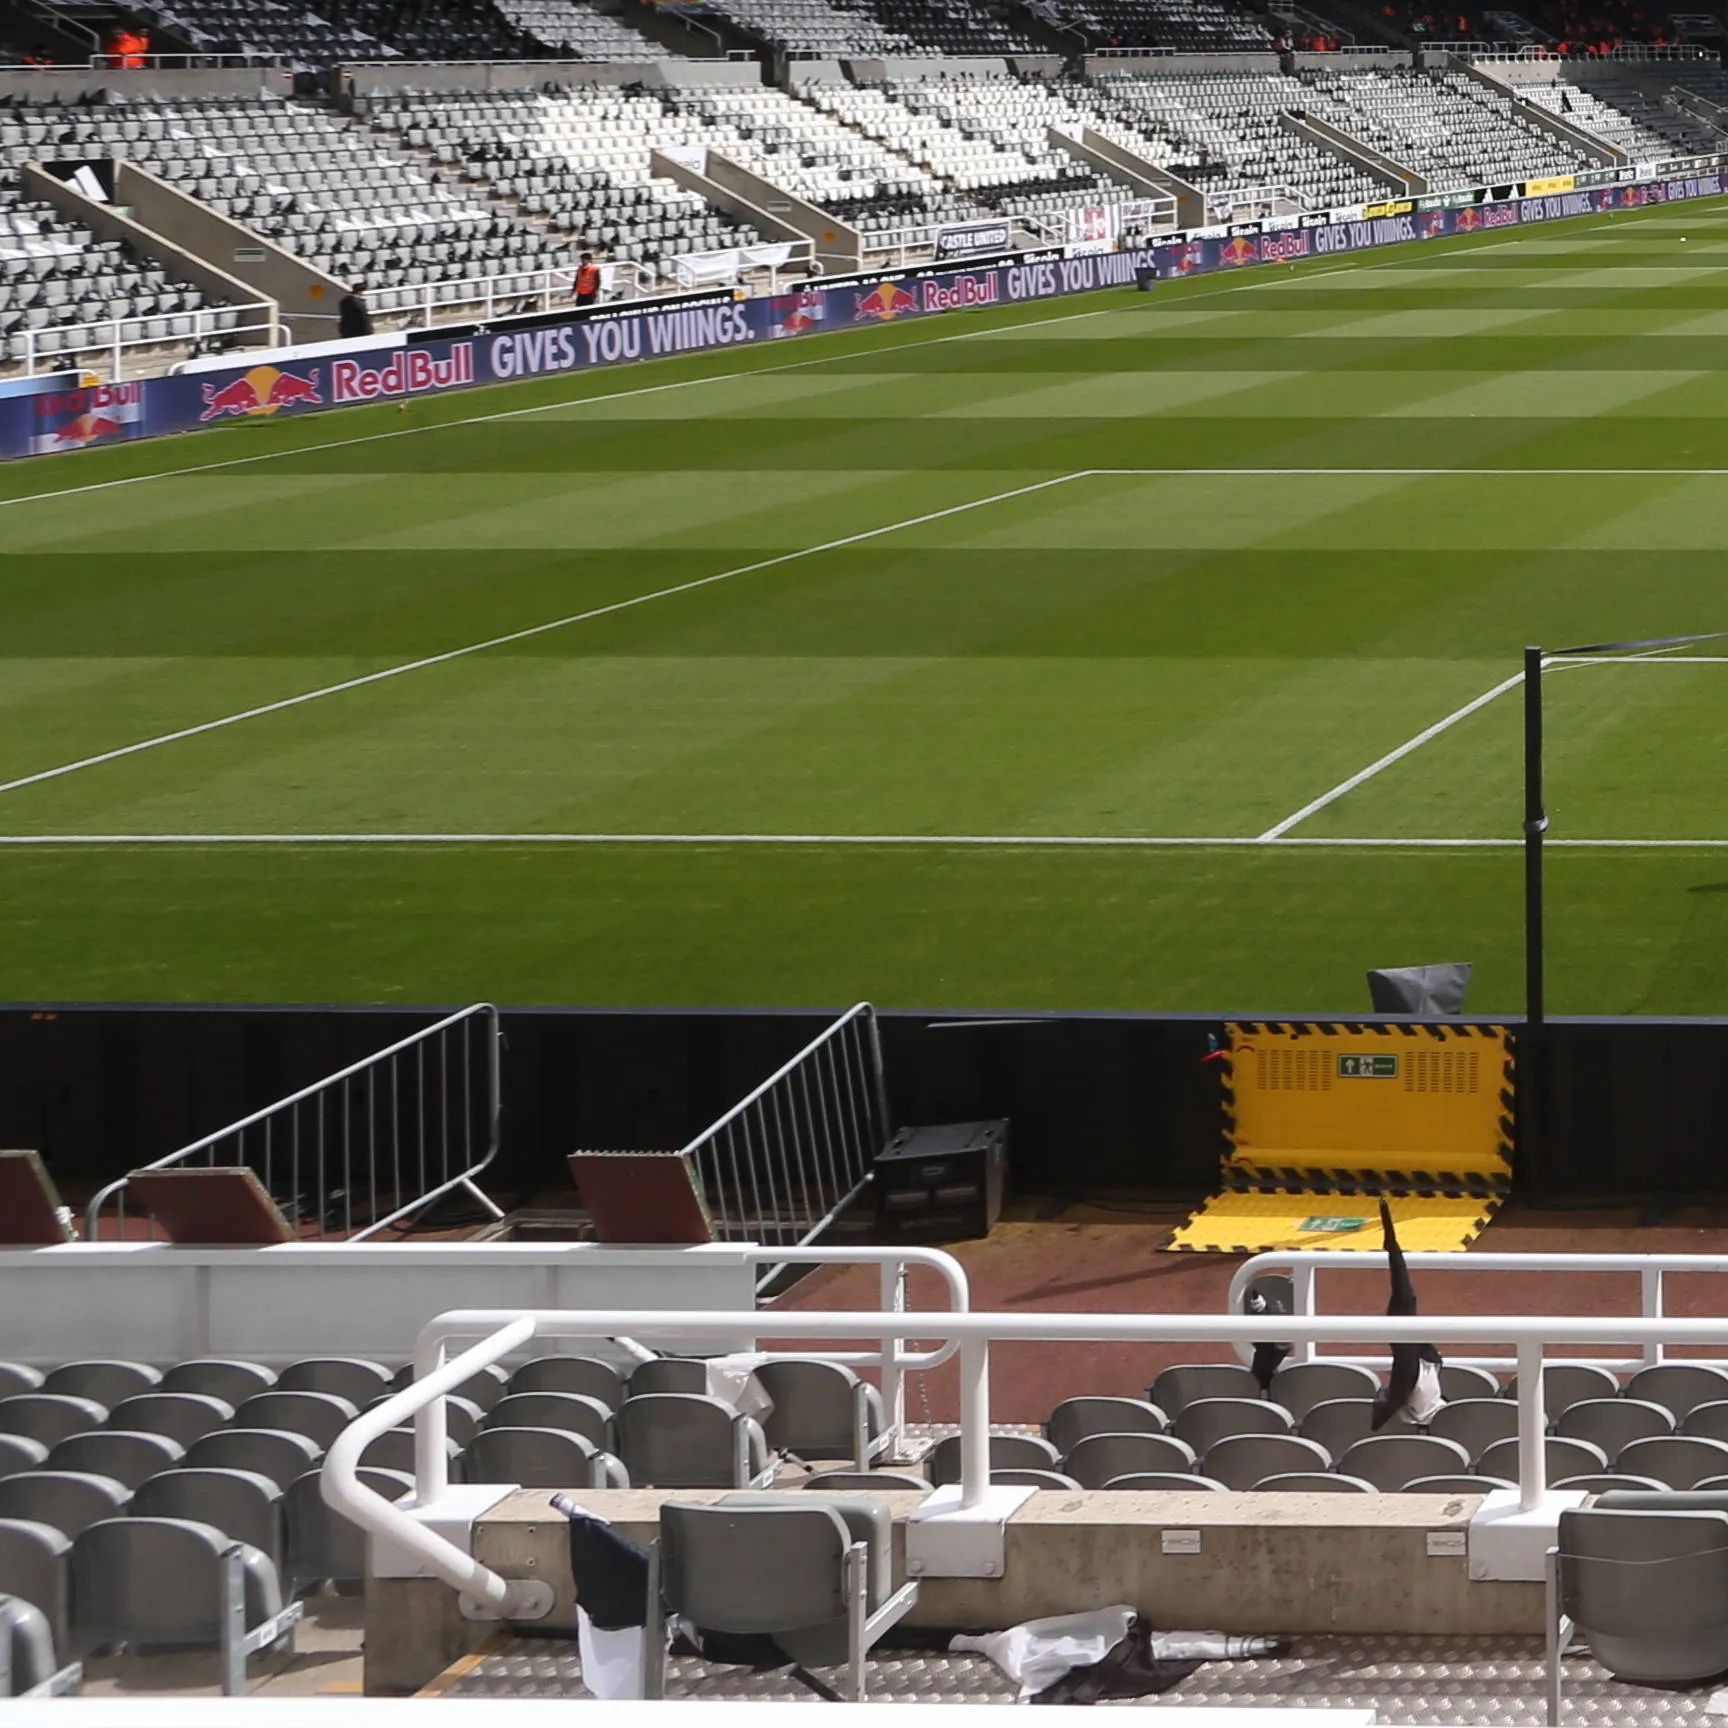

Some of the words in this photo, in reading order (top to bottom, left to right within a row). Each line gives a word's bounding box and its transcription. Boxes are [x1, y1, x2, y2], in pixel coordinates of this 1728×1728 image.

[1521, 198, 1544, 222] GIVES
[1545, 195, 1561, 218] YOU
[1261, 234, 1287, 260] Red
[1287, 229, 1310, 255] Bull
[1315, 223, 1347, 253] GIVES
[1349, 220, 1372, 250] YOU
[1373, 216, 1416, 245] WIIINGS.
[923, 276, 963, 311] Red
[963, 271, 999, 305] Bull
[1007, 263, 1056, 300] GIVES
[1059, 258, 1094, 292] YOU
[491, 325, 576, 379] GIVES
[581, 316, 641, 364] YOU
[649, 303, 756, 354] WIIINGS.
[331, 350, 406, 404] Red
[407, 341, 475, 392] Bull
[35, 390, 89, 416] Red
[93, 381, 141, 409] Bull
